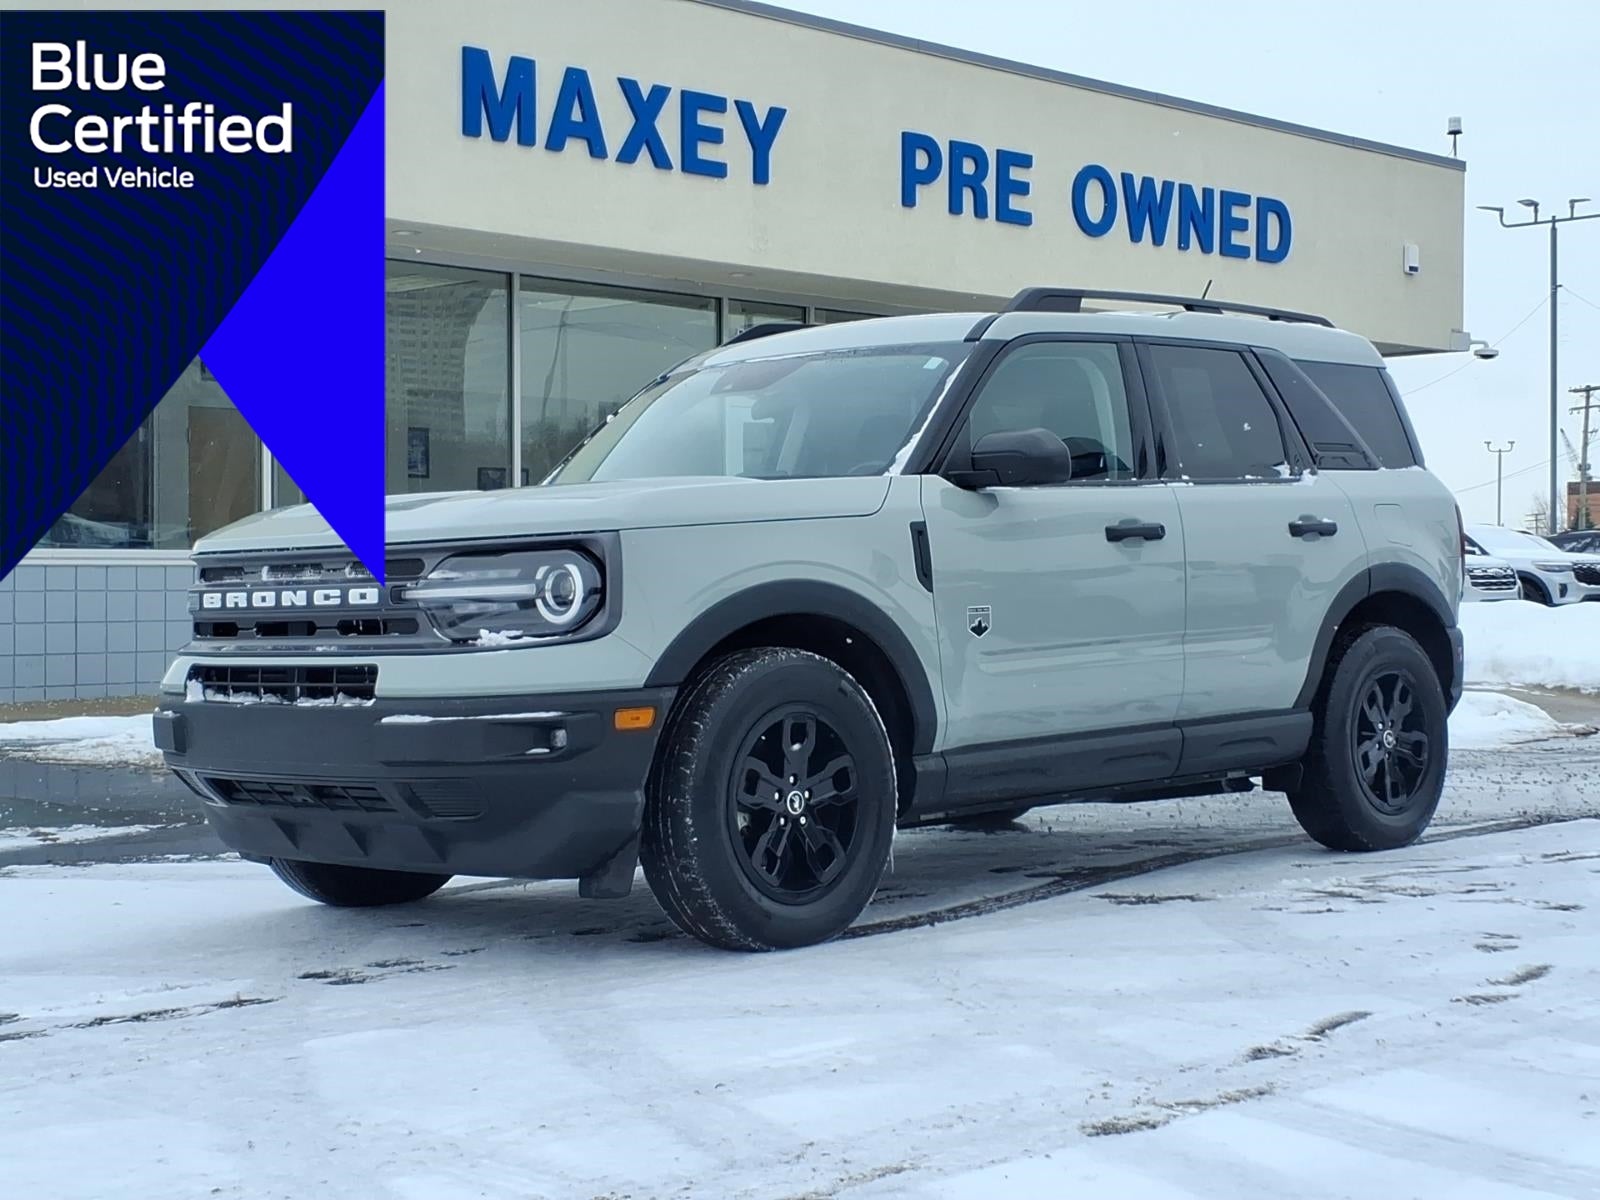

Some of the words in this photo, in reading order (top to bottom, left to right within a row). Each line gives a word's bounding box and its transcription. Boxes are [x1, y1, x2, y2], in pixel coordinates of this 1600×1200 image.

[461, 45, 787, 186] MAXEY
[900, 130, 1033, 227] PRE
[1071, 163, 1292, 264] OWNED
[203, 588, 379, 608] BRONCO
